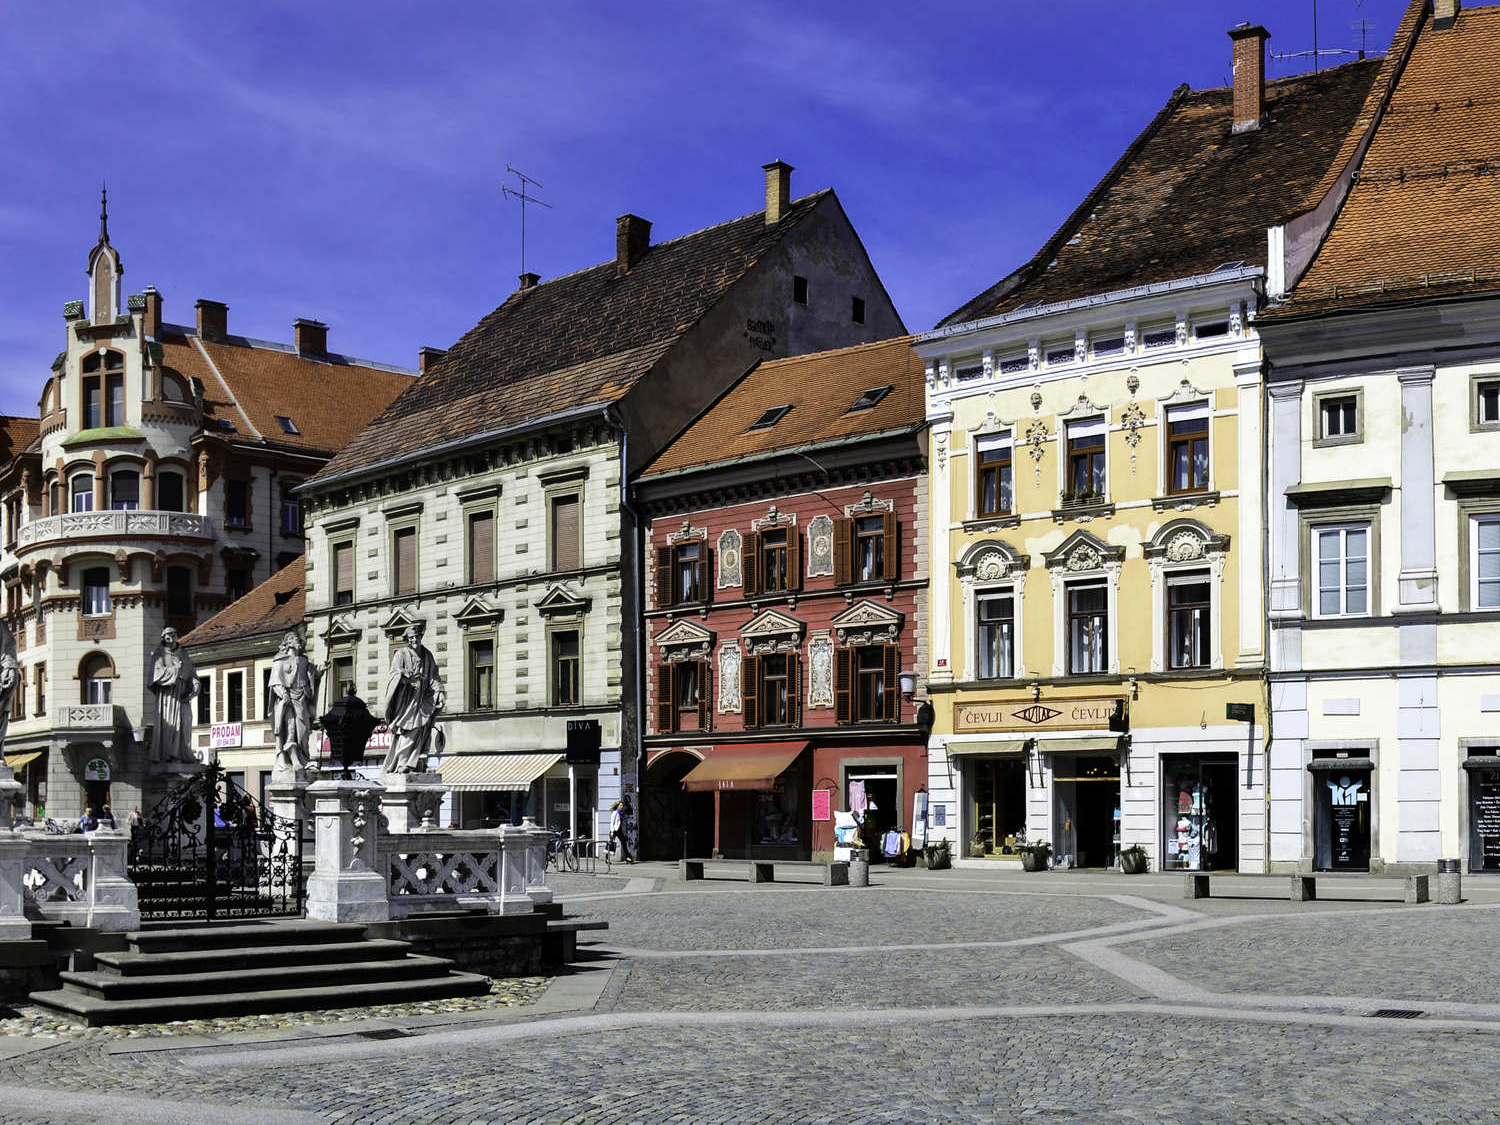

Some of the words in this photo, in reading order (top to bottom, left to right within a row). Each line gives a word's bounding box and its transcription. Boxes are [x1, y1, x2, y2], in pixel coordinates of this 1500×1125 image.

[966, 711, 1002, 724] ČEVLJI
[211, 725, 241, 739] PRODAM
[567, 723, 591, 731] DIVA
